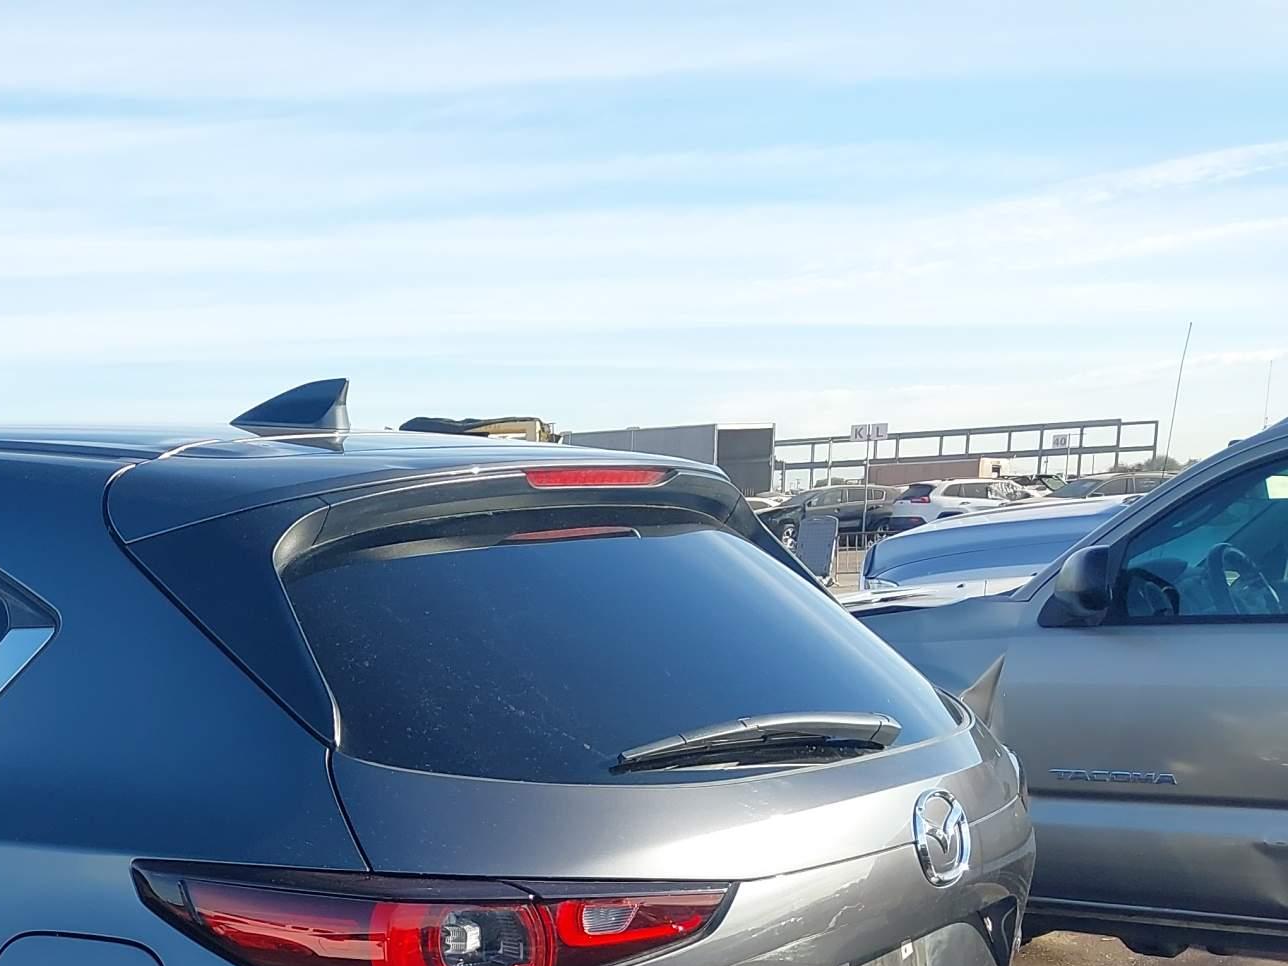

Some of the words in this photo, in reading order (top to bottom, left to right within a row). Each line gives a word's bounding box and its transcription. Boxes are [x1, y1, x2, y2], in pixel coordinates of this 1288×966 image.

[854, 426, 864, 439] K
[876, 426, 884, 438] L
[1048, 768, 1178, 785] TACOMA
